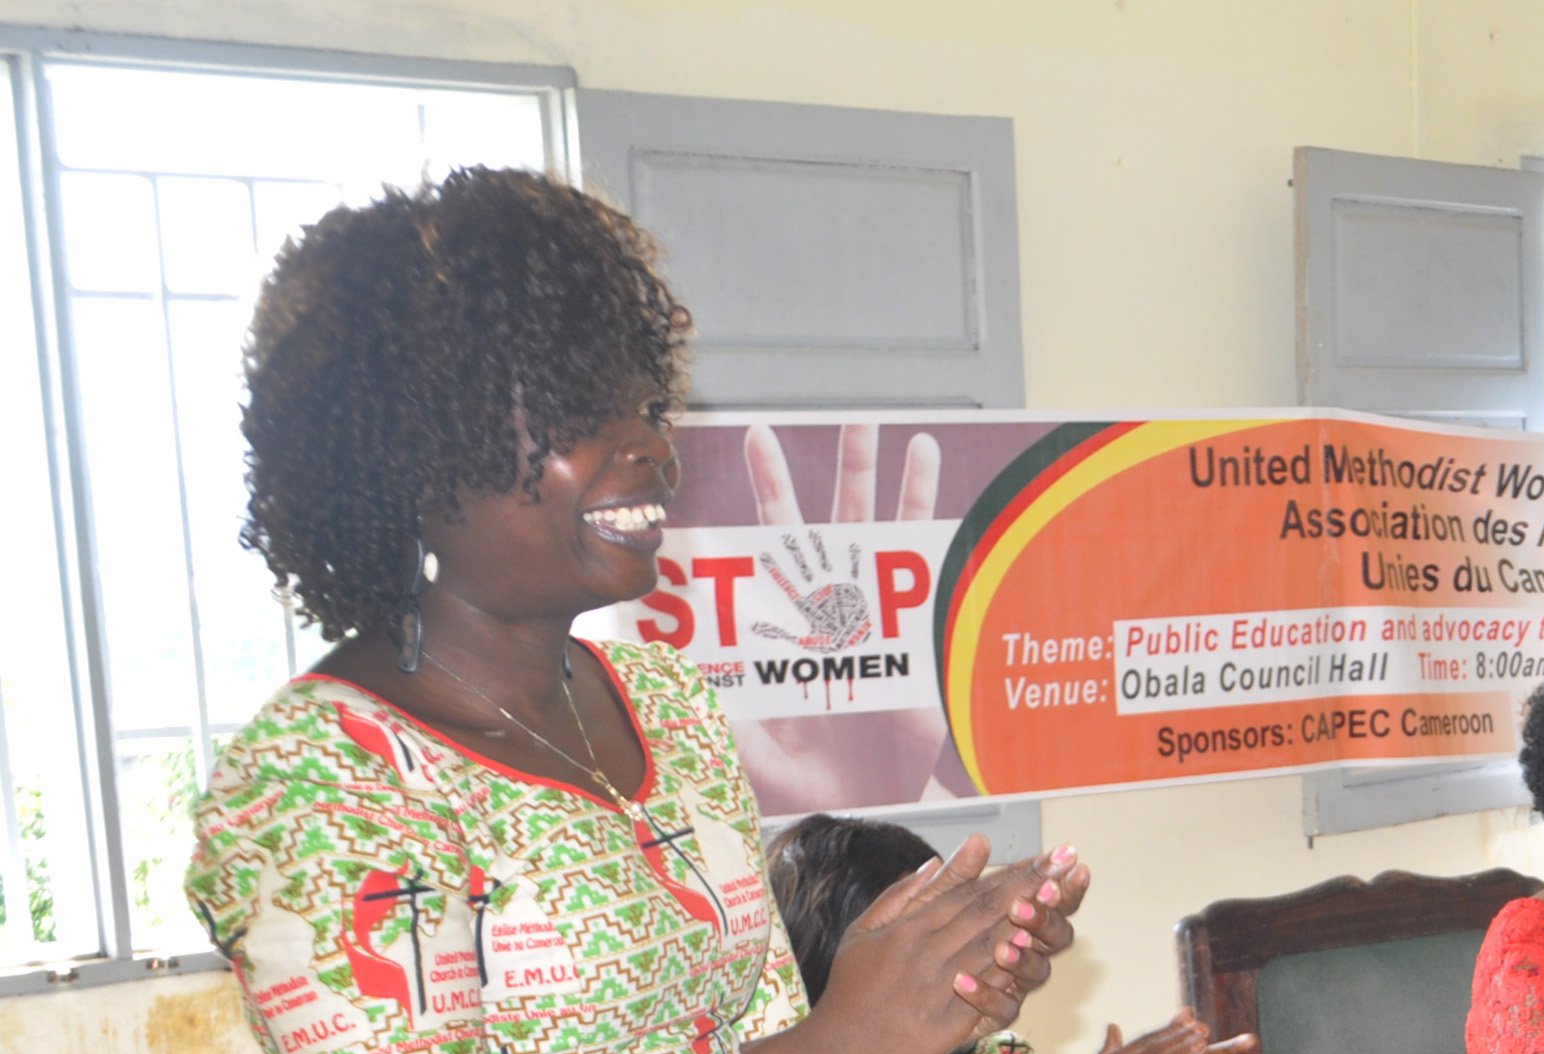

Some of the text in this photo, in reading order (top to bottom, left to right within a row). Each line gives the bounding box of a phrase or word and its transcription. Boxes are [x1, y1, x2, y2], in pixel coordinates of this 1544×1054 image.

[1189, 444, 1311, 488] United
[1323, 444, 1487, 495] Methodist
[1281, 499, 1466, 542] Association
[1472, 508, 1529, 547] des
[1362, 551, 1440, 592] Unies
[1453, 555, 1493, 593] du
[1002, 632, 1114, 666] Theme:
[1125, 620, 1219, 657] Public
[1231, 614, 1367, 650] Education
[1381, 615, 1416, 641] and
[1422, 613, 1531, 648] advocacy
[754, 653, 909, 684] WOMEN
[1004, 676, 1109, 710] Venue:
[1121, 665, 1206, 700] Obala
[1219, 655, 1320, 693] Council
[1328, 652, 1388, 683] Hall
[1417, 652, 1468, 681] Time:
[1157, 707, 1494, 763] Sponsors: CAPEC Cameroon
